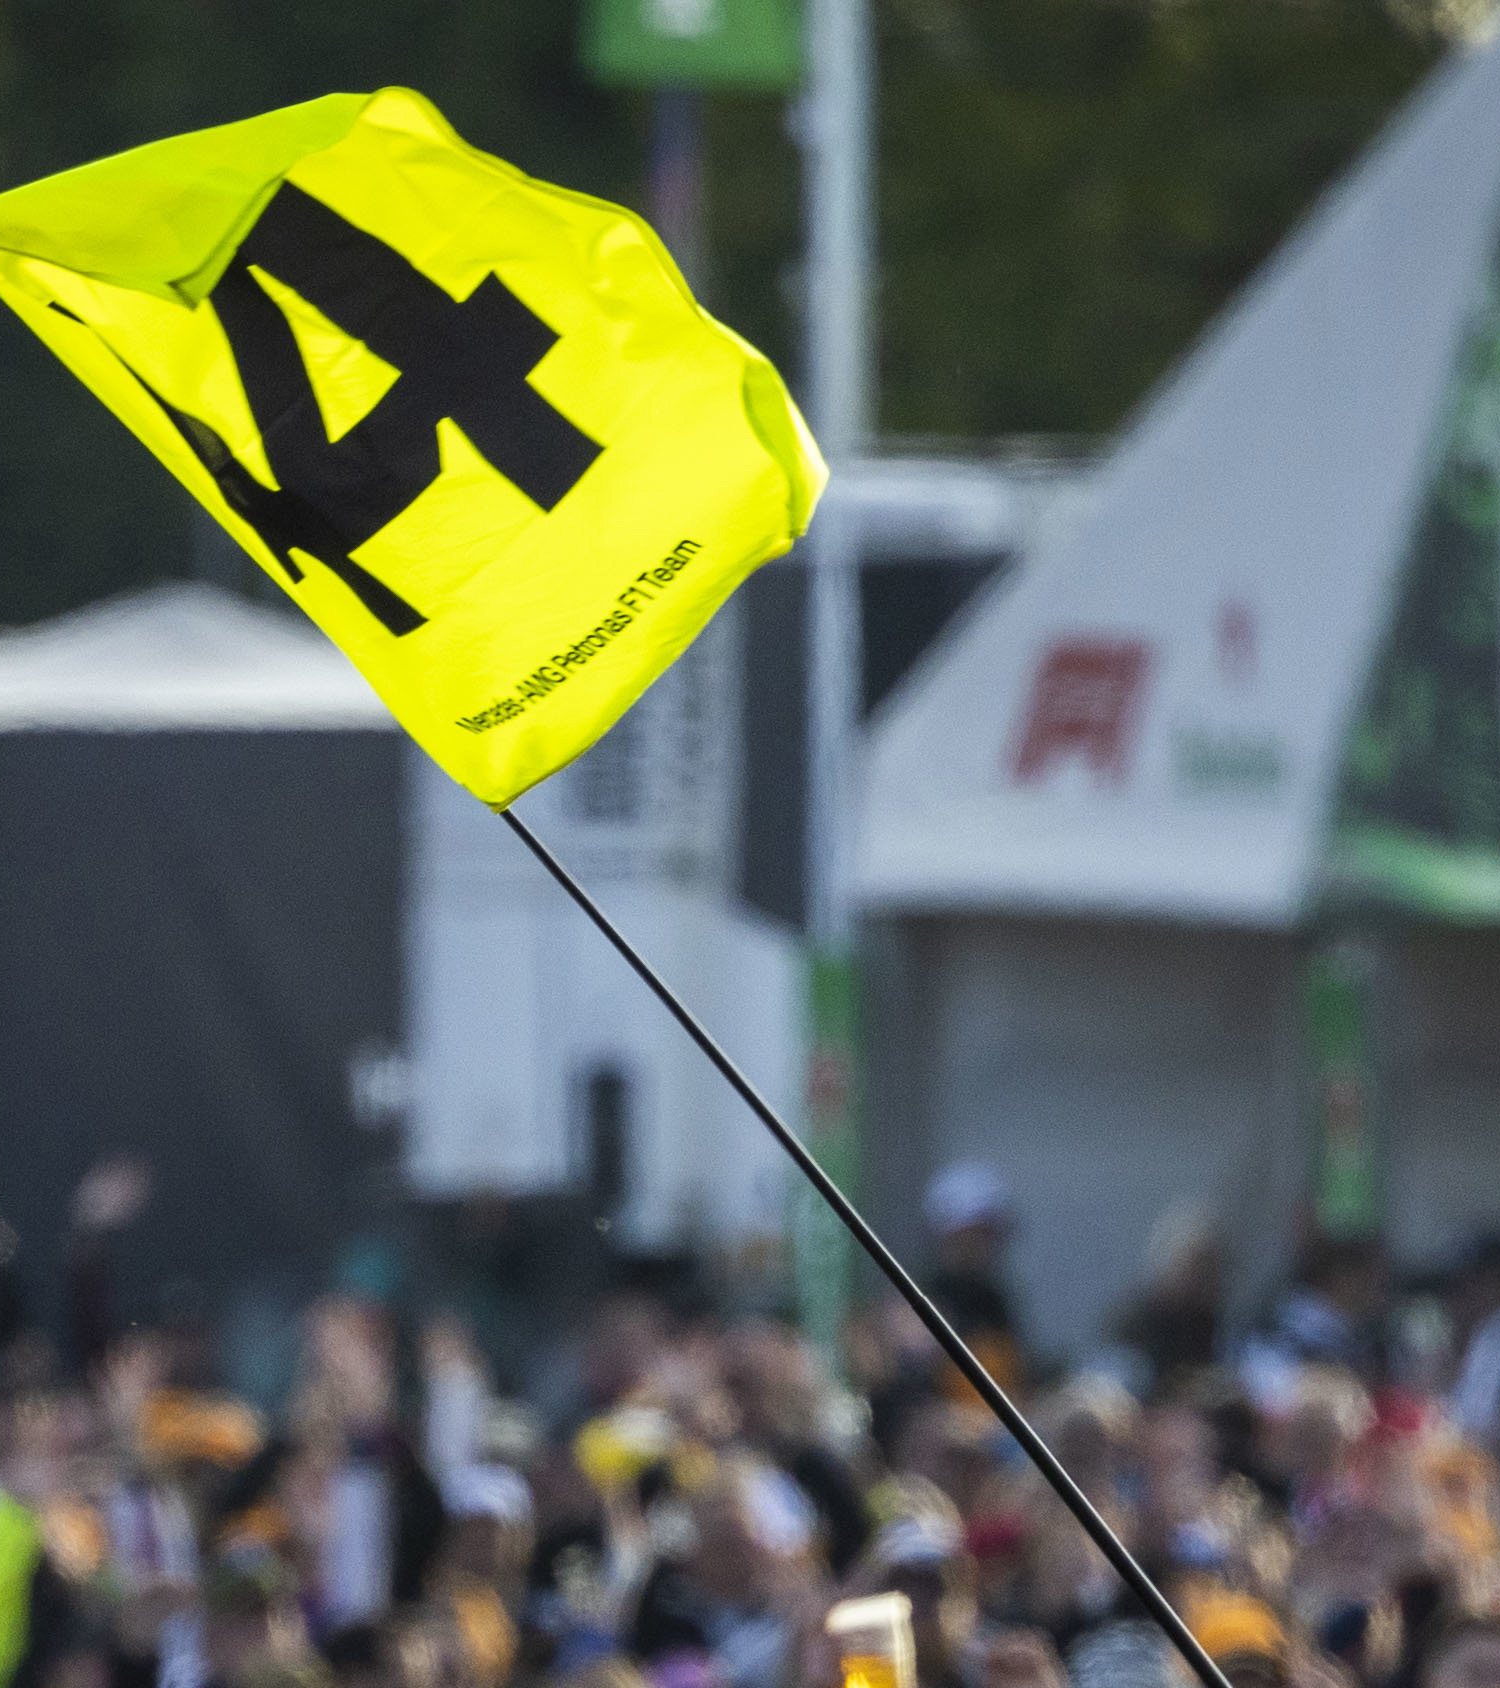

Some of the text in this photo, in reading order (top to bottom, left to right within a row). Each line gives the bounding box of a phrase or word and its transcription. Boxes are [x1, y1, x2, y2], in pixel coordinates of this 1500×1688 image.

[551, 609, 633, 674] Petronas
[618, 586, 656, 613] F1
[637, 539, 702, 589] Team
